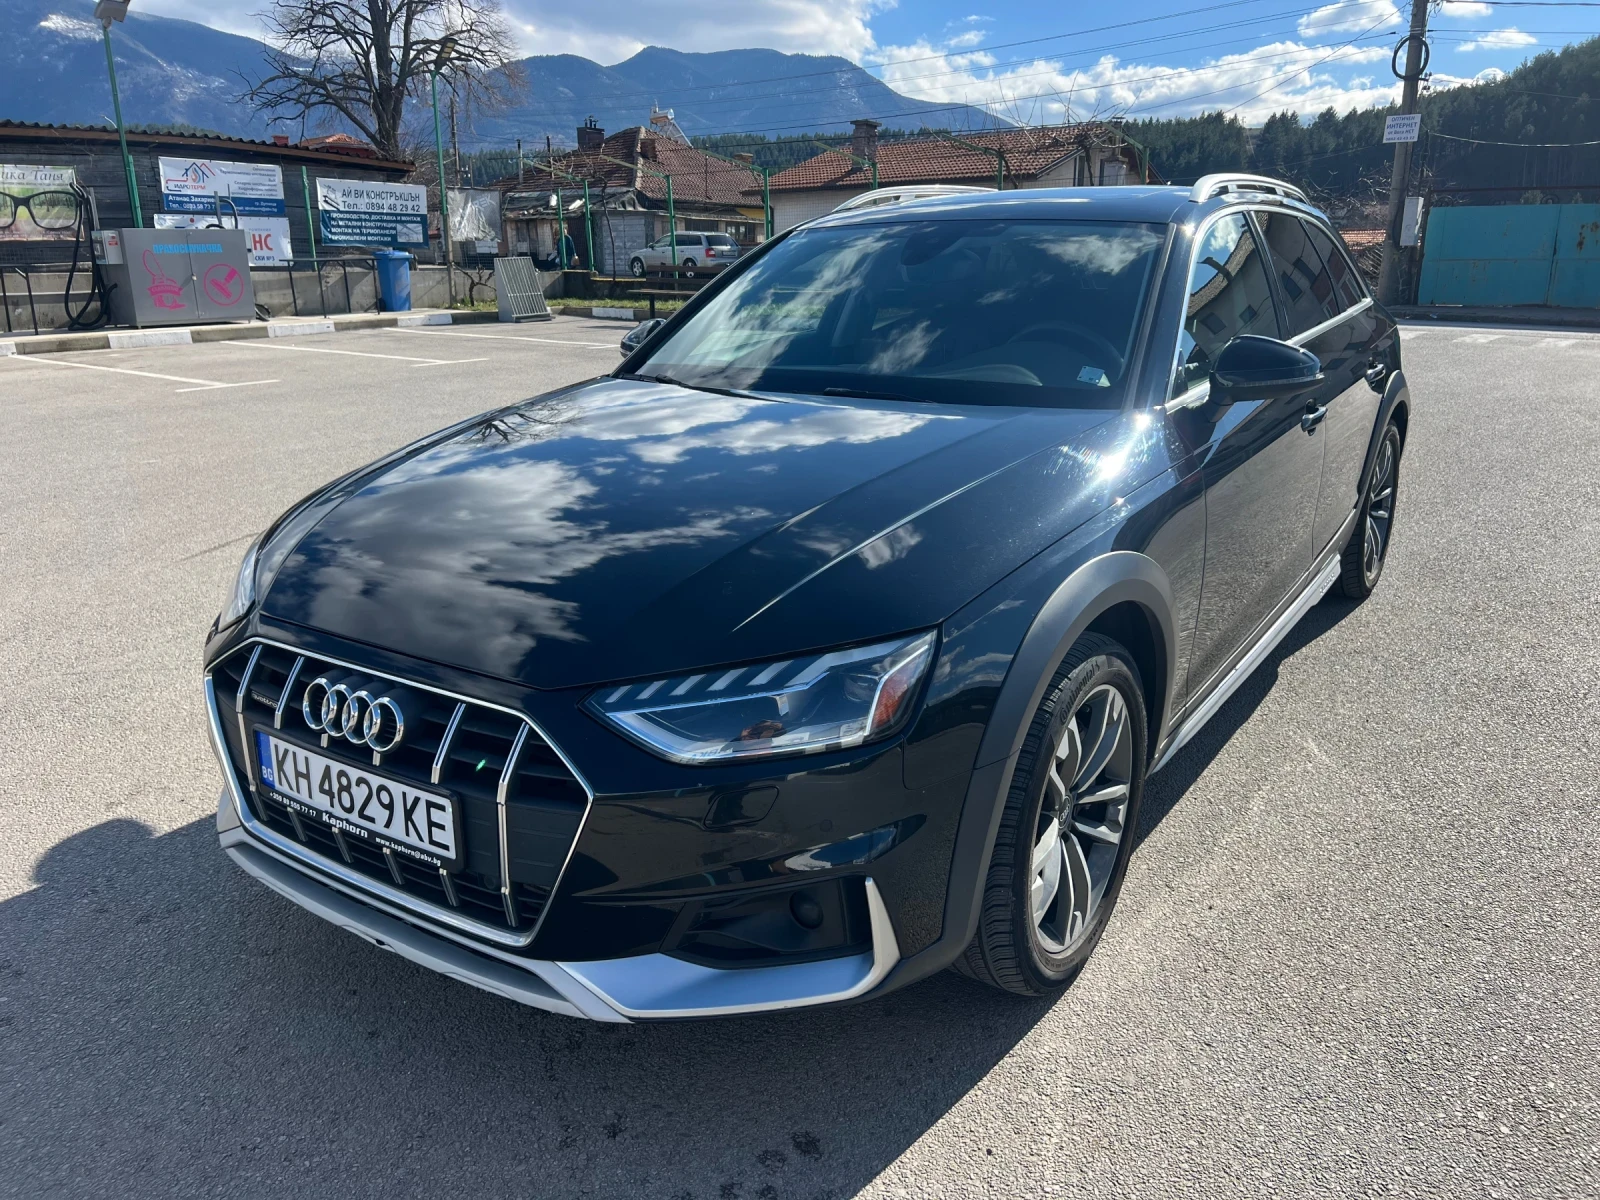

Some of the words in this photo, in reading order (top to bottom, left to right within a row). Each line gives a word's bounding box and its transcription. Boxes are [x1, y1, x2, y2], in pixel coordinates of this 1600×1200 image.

[31, 169, 63, 181] Таня
[342, 187, 353, 198] АЙ
[354, 190, 365, 200] ВИ
[366, 191, 420, 202] КОНСТРЪКШЪН
[342, 201, 363, 209] Тел.:
[366, 202, 385, 211] 0894
[388, 204, 397, 212] 48
[400, 204, 409, 212] 29
[411, 205, 420, 213] 42
[153, 243, 223, 253] ПРАХОСМУКАЧКА
[252, 233, 274, 251] НС
[252, 693, 278, 708] quattro
[261, 766, 273, 780] BG
[318, 764, 394, 830] 4829
[322, 812, 368, 838] Kaphorn
[375, 837, 441, 867] www.kaphorn@abv.bg
